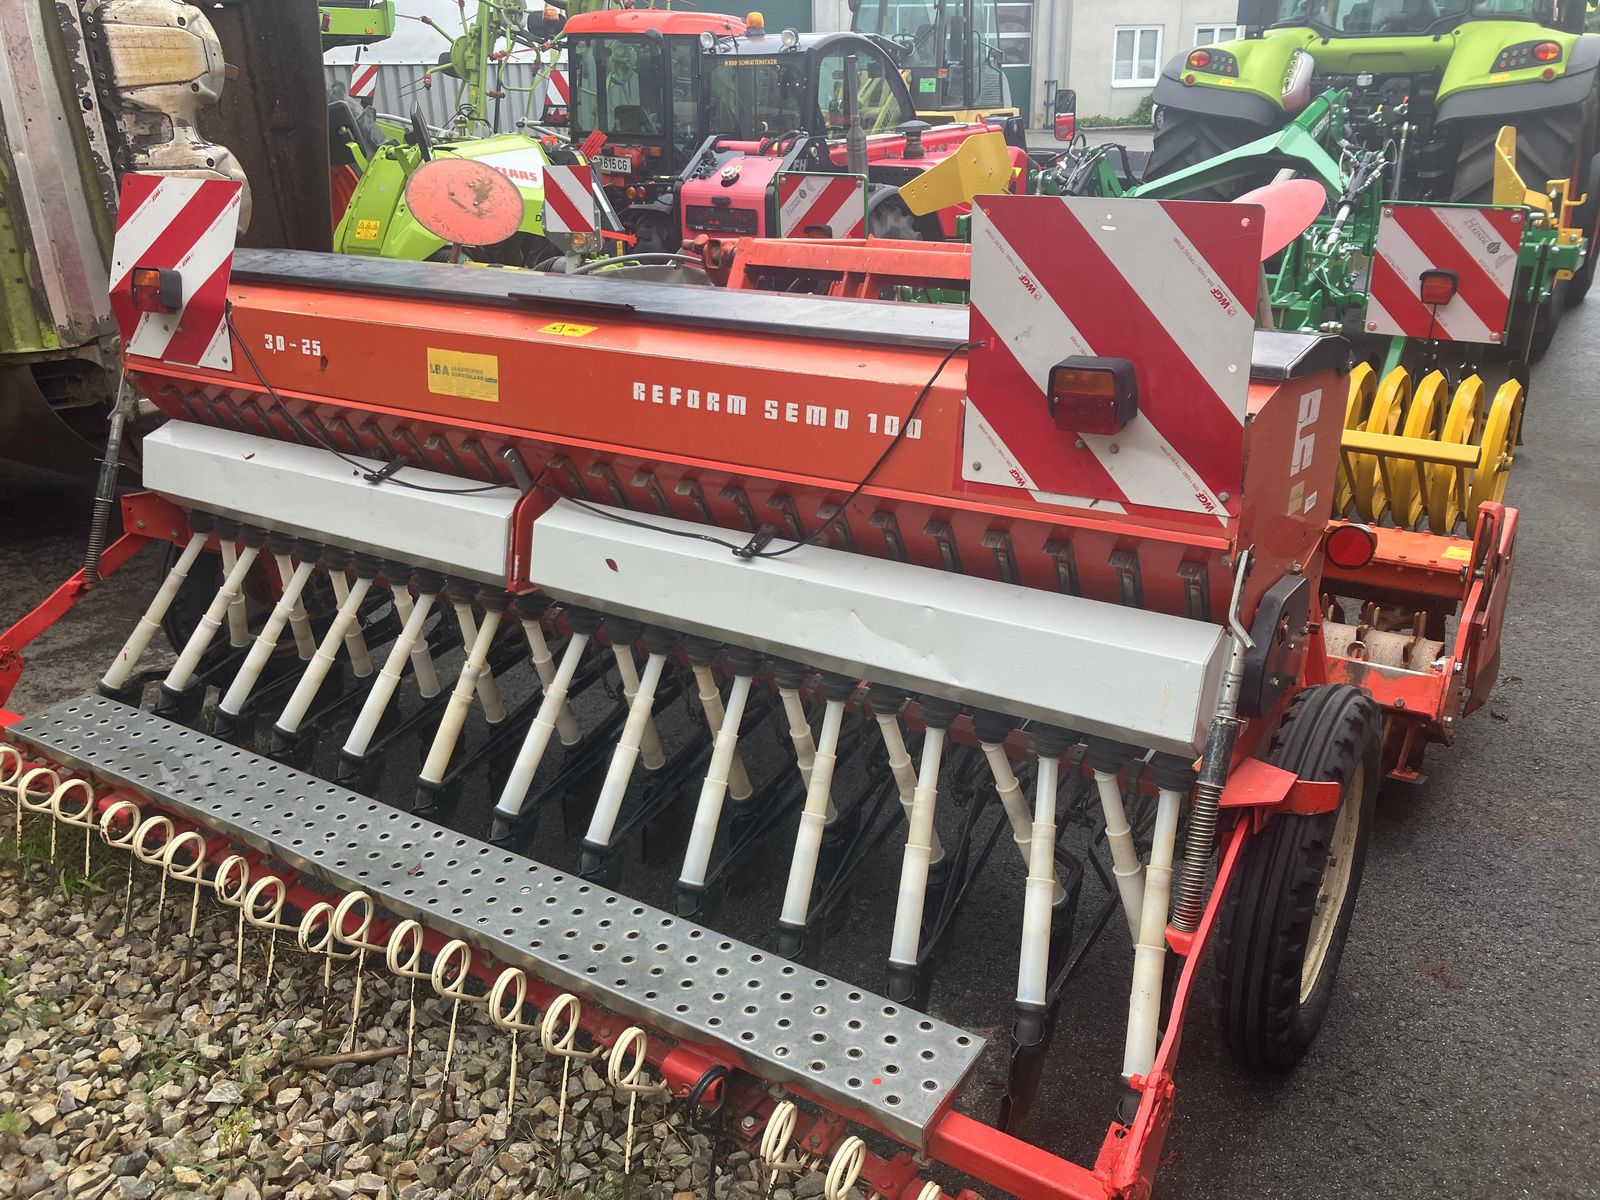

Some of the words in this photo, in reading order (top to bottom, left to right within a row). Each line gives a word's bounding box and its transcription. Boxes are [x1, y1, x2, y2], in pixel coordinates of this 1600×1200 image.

[1018, 275, 1037, 295] WGF
[1210, 288, 1231, 309] WGF
[264, 333, 285, 354] 3,0
[301, 338, 321, 356] 25
[429, 362, 450, 377] LBA
[633, 381, 747, 416] REFORM
[764, 399, 849, 430] SEMO
[867, 412, 922, 440] 100
[1009, 468, 1026, 487] WGF
[1195, 492, 1215, 512] WGF
